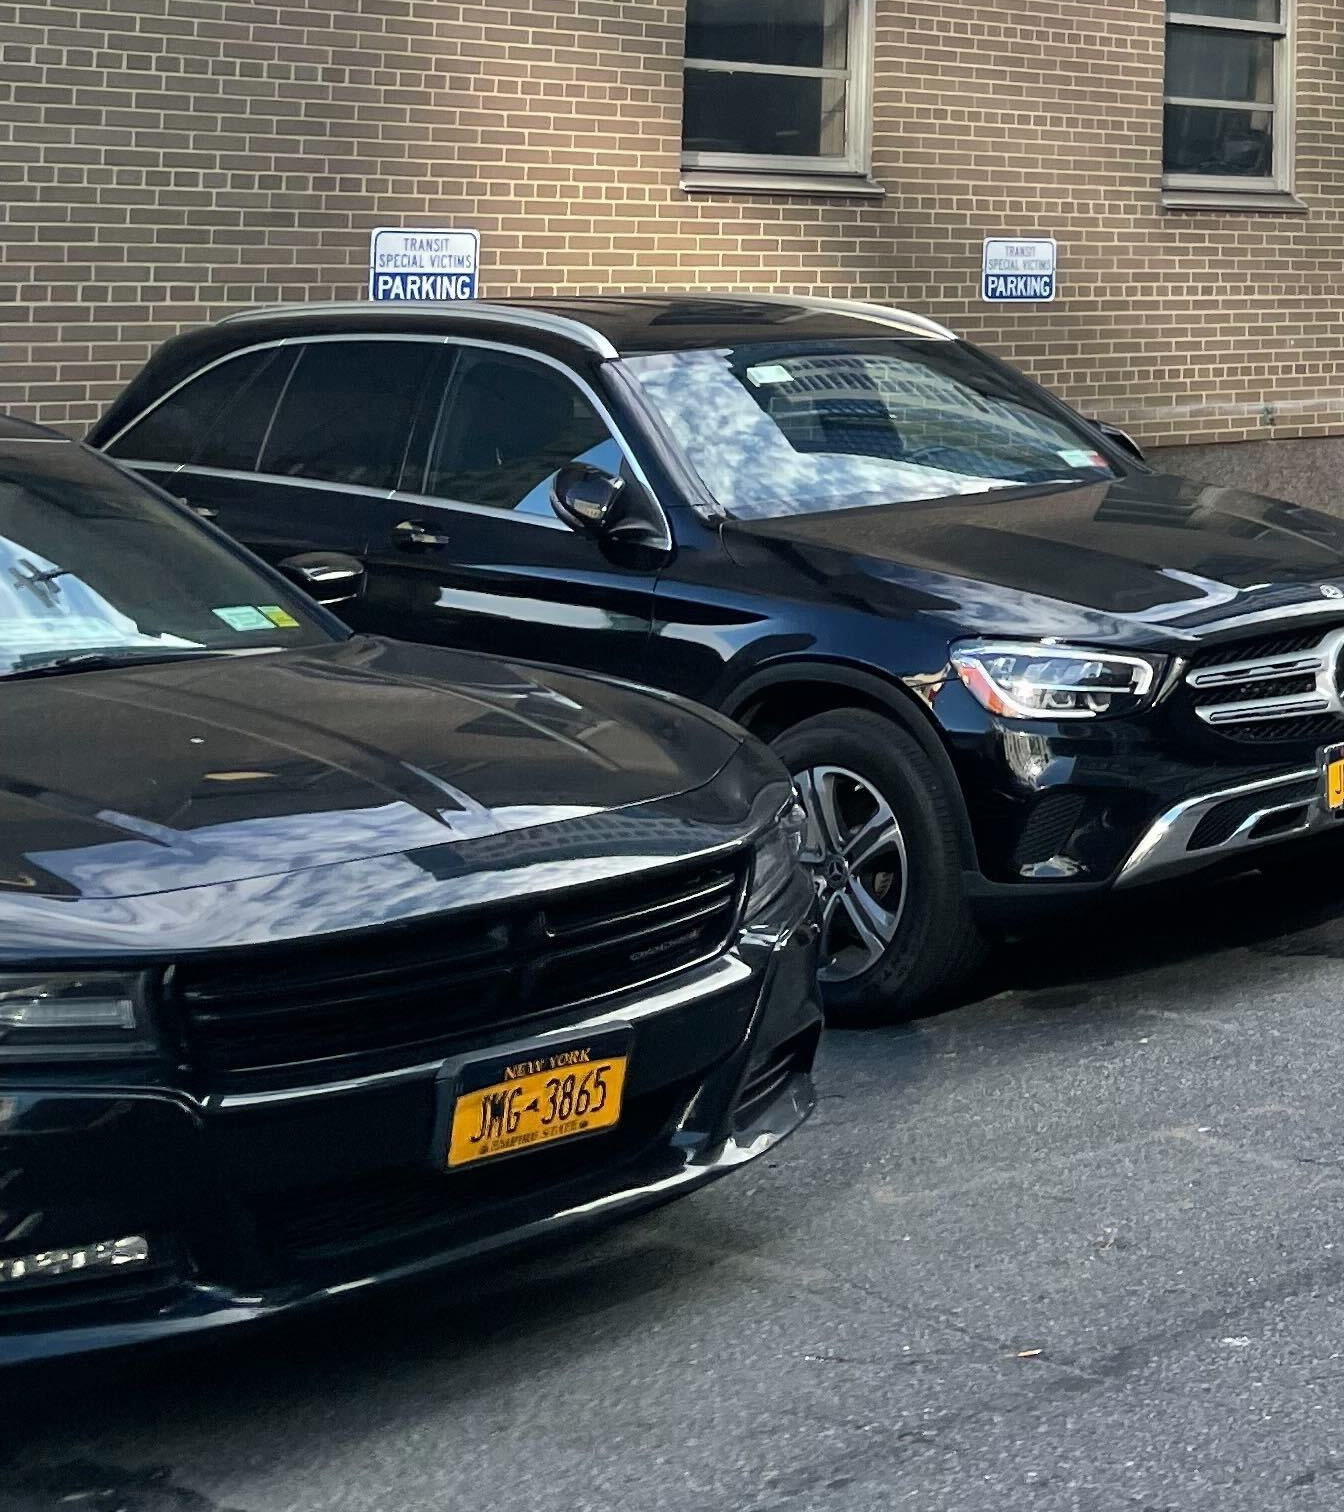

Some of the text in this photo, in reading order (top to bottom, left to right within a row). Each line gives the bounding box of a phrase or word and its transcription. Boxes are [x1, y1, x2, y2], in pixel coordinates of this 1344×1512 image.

[404, 237, 450, 252] TRANSIT
[1005, 245, 1036, 257] TRANSIT
[379, 253, 472, 268] SPECIAL VICTIMS
[988, 258, 1019, 271] SPECIAL
[377, 275, 471, 300] PARKING
[987, 276, 1050, 297] PARKING
[504, 1047, 592, 1081] NEW YORK
